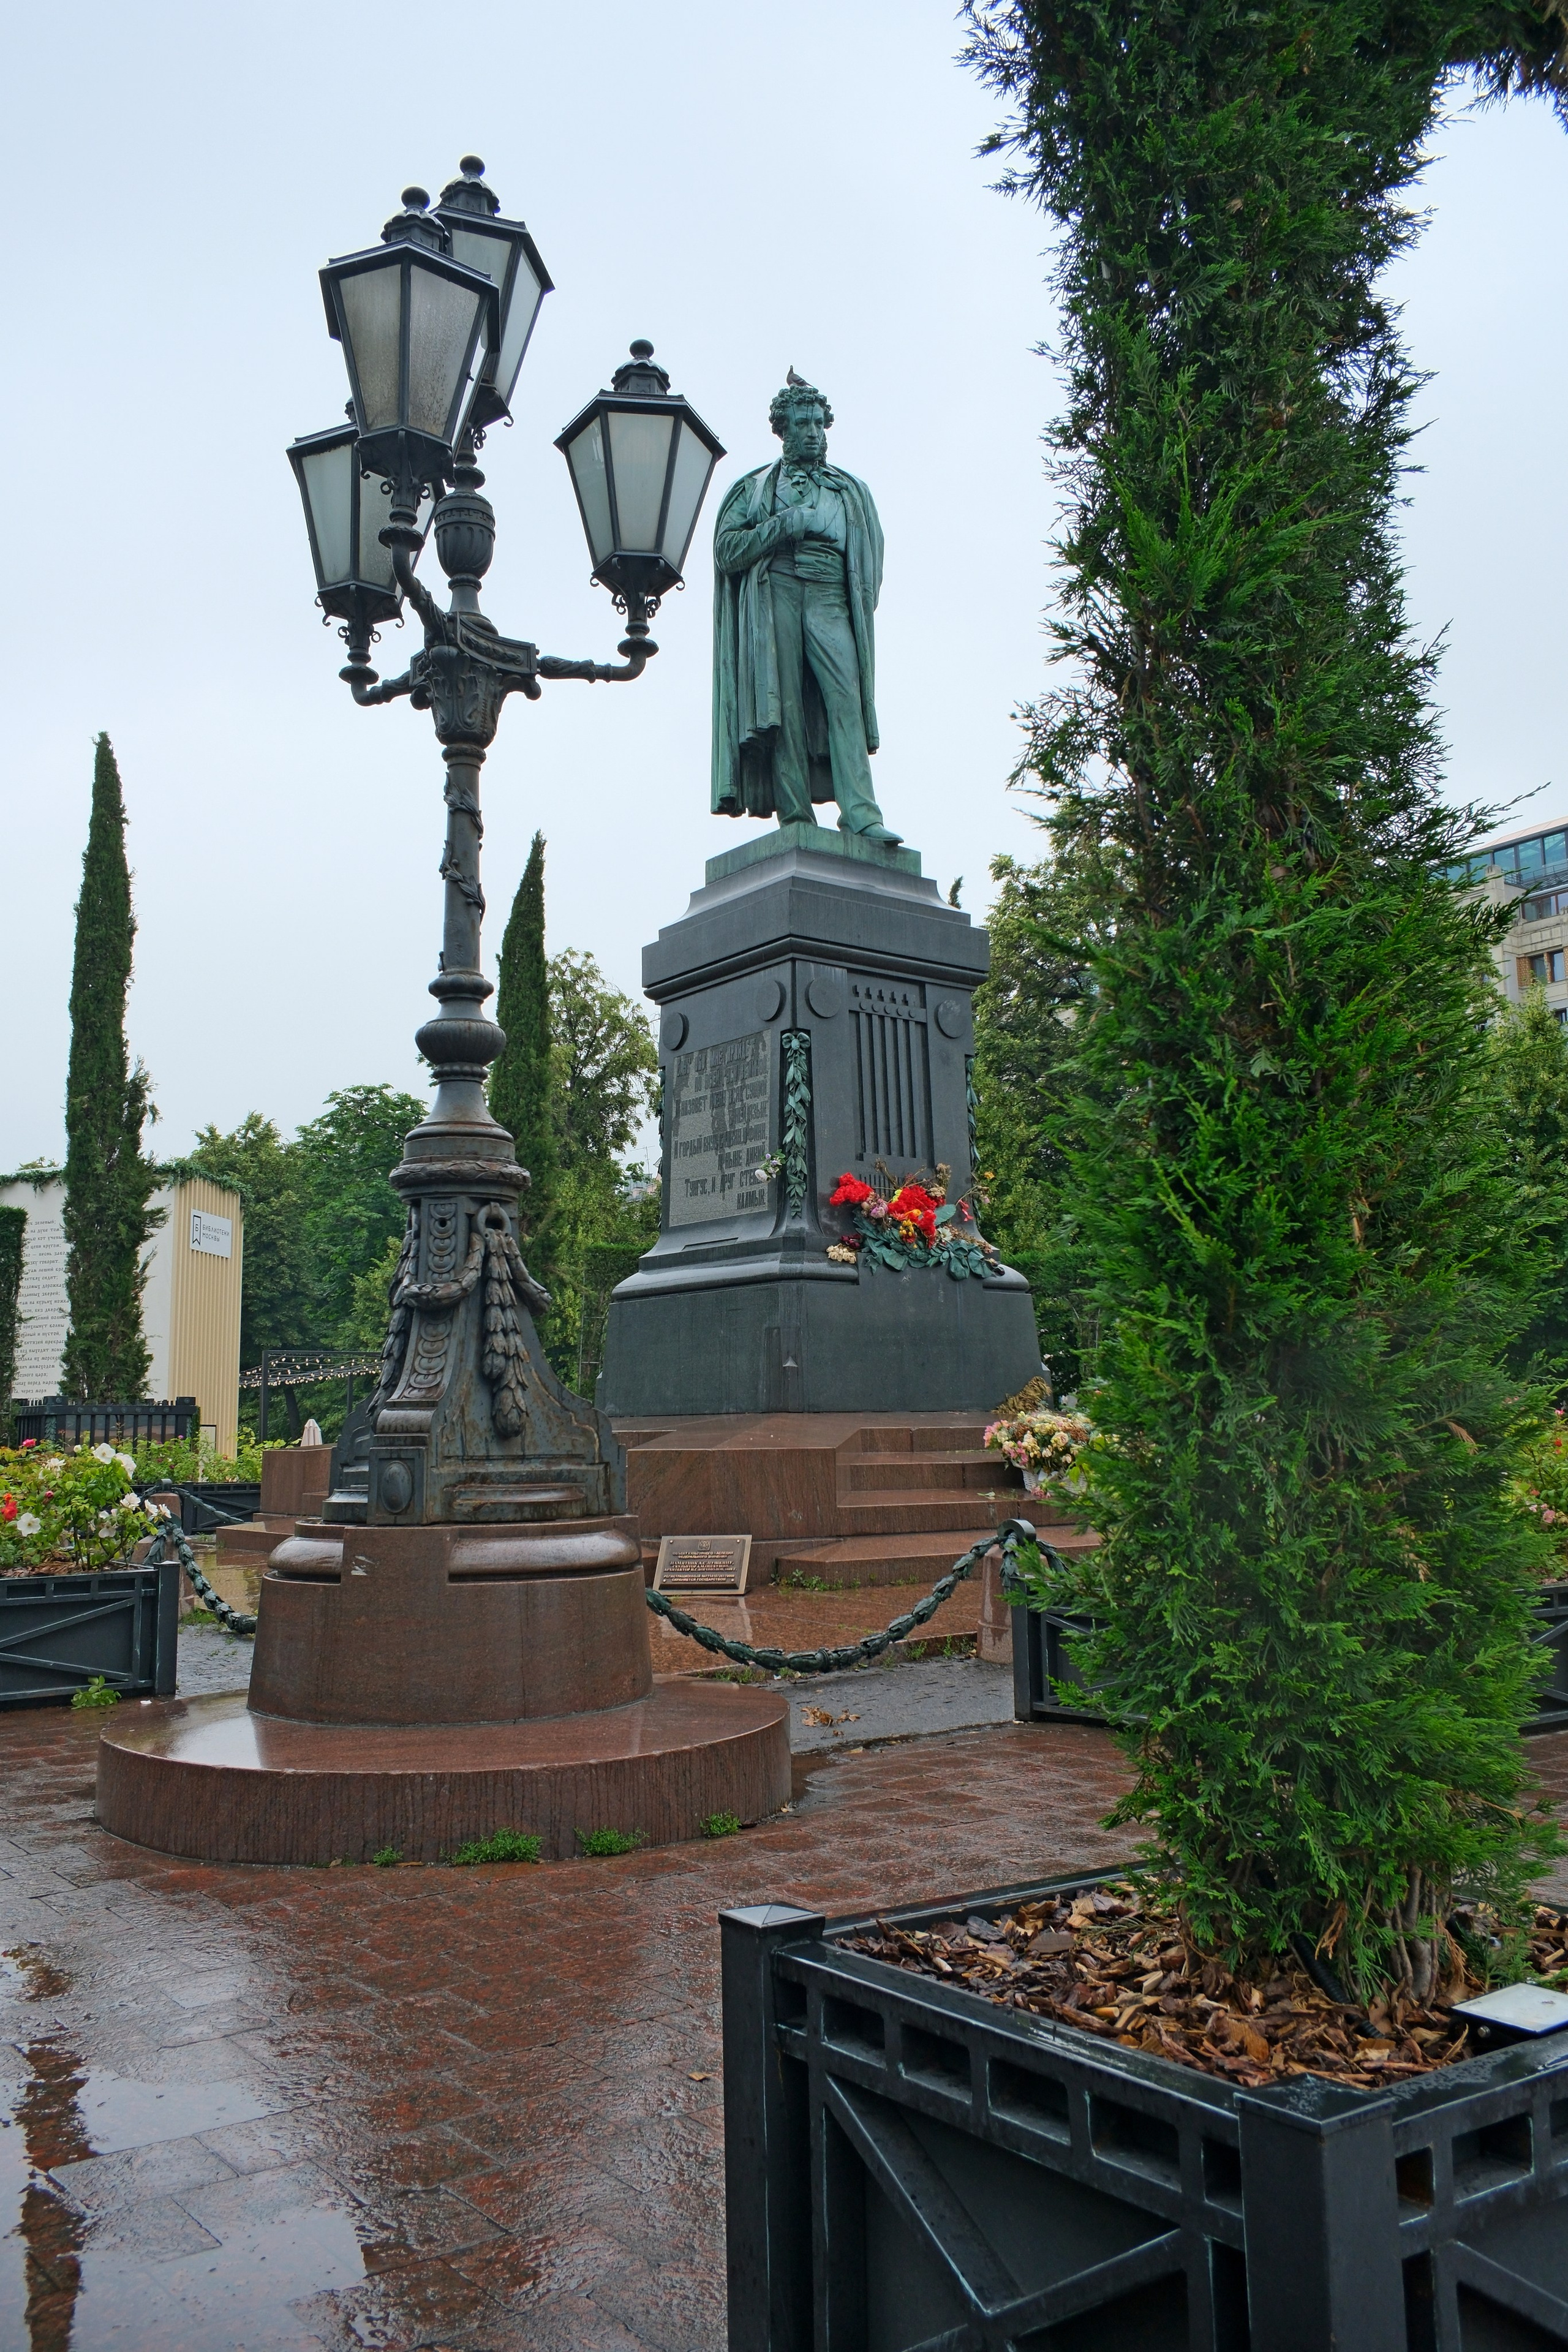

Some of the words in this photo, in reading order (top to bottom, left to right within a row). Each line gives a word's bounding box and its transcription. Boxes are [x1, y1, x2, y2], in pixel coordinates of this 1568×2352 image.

[710, 1048, 723, 1068] МНЕ
[680, 1095, 707, 1117] НАЗОВЕТ
[745, 1077, 767, 1101] СУЩИЙ
[674, 1140, 678, 1159] И
[679, 1134, 703, 1158] ГОРДЫЙ
[725, 1149, 742, 1169] НЫНЕ
[685, 1178, 710, 1198] ТУНГУС,
[711, 1175, 715, 1193] И
[720, 1172, 736, 1194] ДРУГ
[203, 1224, 230, 1237] БИБЛИОТЕКИ
[203, 1232, 220, 1242] МОСКВЫ
